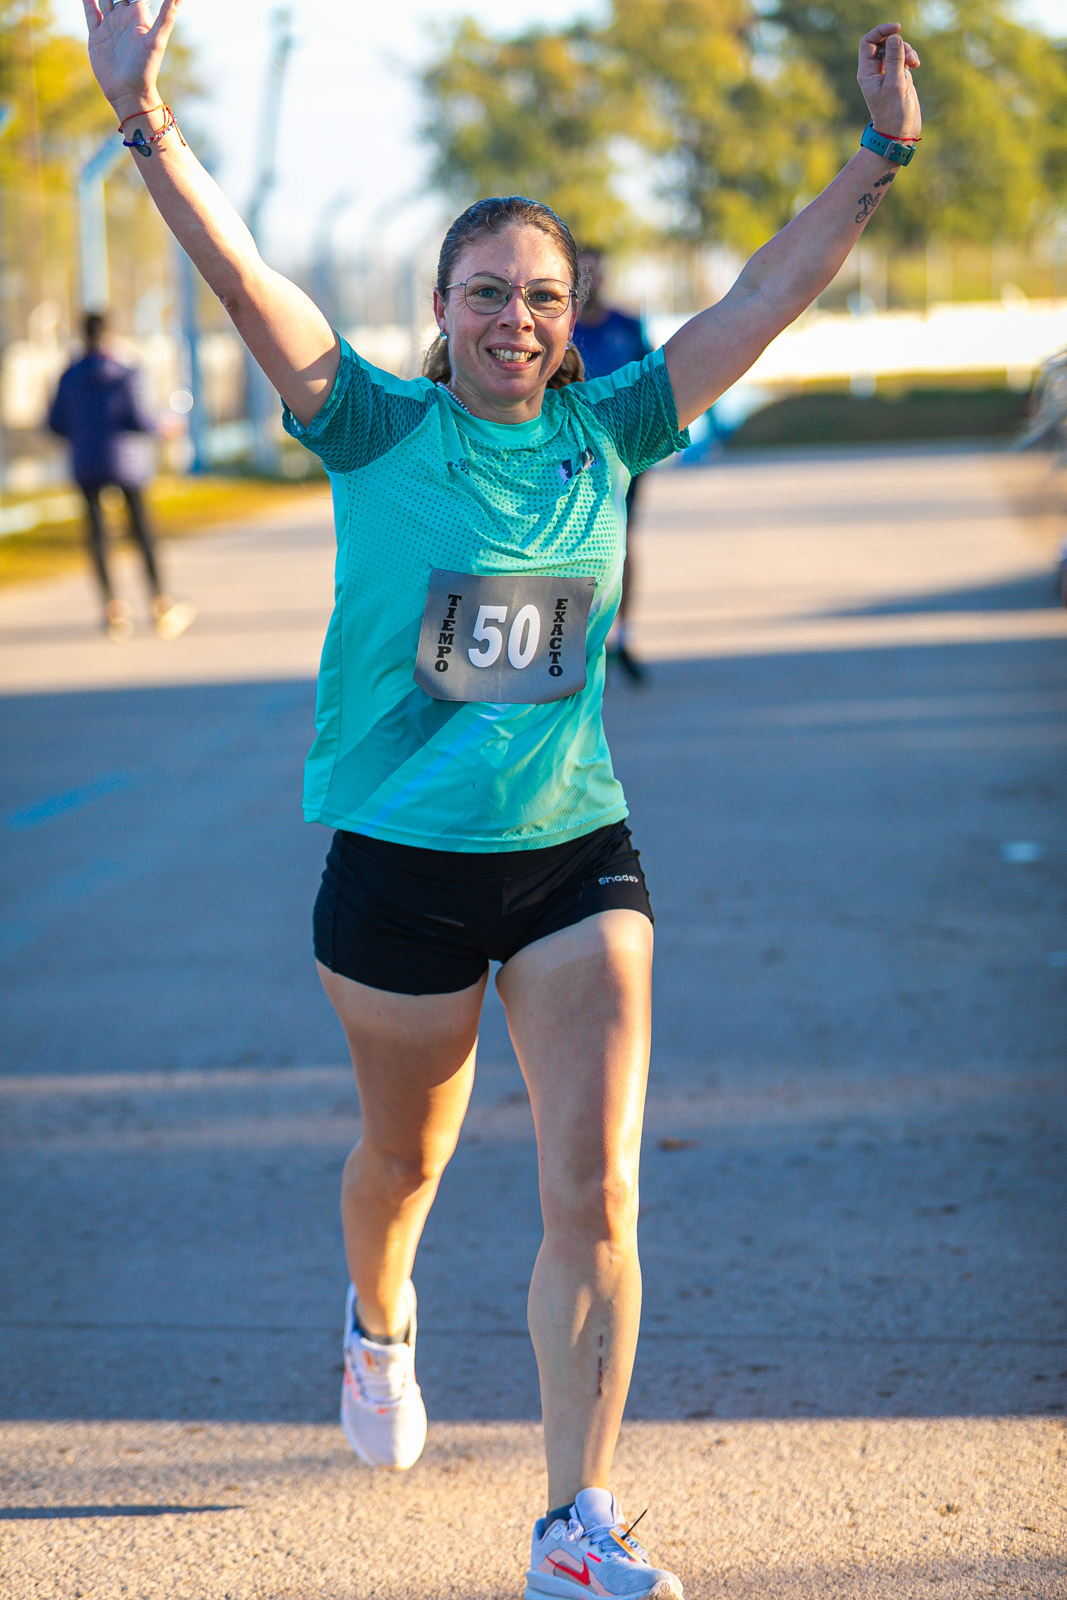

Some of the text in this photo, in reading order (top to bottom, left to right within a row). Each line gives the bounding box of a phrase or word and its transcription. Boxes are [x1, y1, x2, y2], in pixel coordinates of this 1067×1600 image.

[434, 594, 462, 673] TIEMPO
[467, 604, 541, 669] 50
[548, 598, 568, 677] EXACTO
